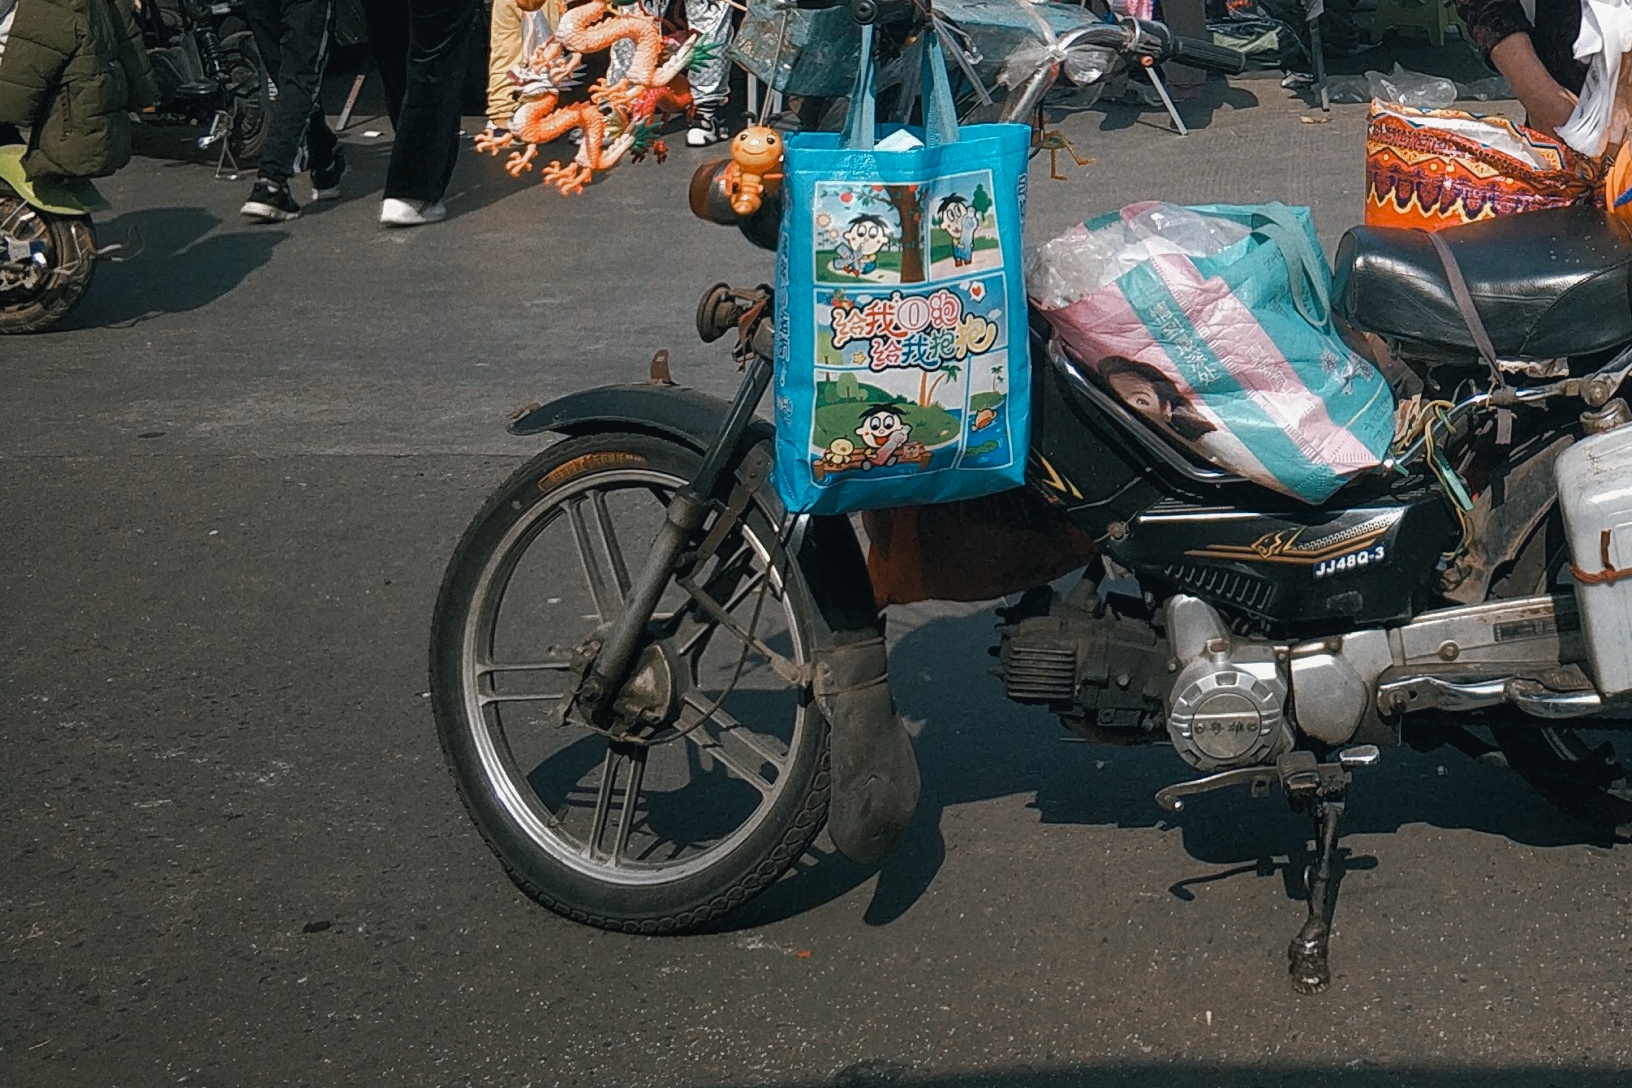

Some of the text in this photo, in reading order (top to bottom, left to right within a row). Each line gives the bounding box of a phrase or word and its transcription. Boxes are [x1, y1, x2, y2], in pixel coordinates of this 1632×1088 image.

[872, 315, 997, 368] 给我抱抱
[1315, 546, 1385, 576] JJ48Q-3
